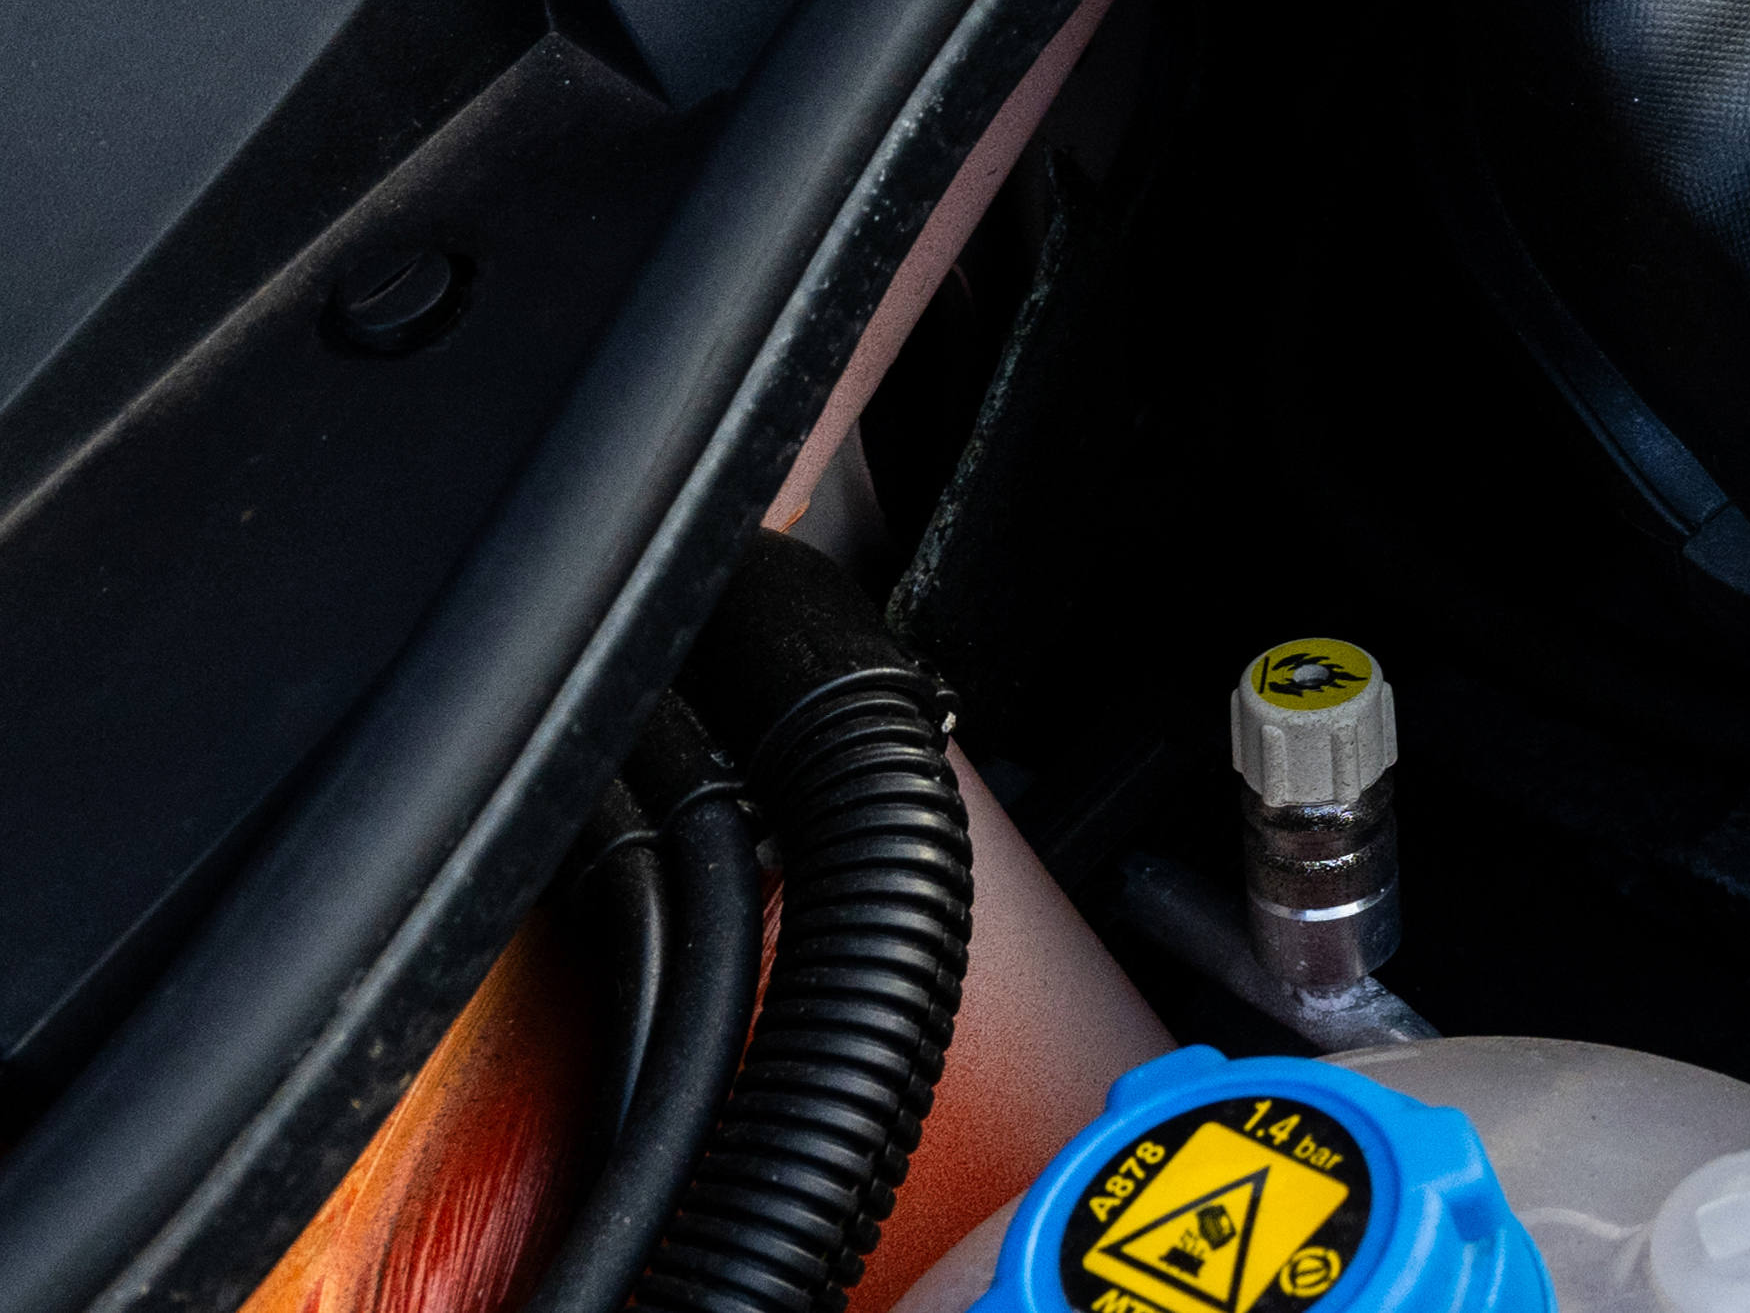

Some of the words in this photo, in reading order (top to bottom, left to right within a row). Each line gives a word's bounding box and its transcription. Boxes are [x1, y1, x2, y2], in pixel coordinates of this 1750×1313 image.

[1243, 1099, 1301, 1146] 1.4
[1292, 1133, 1344, 1171] bar
[1088, 1140, 1166, 1223] A878
